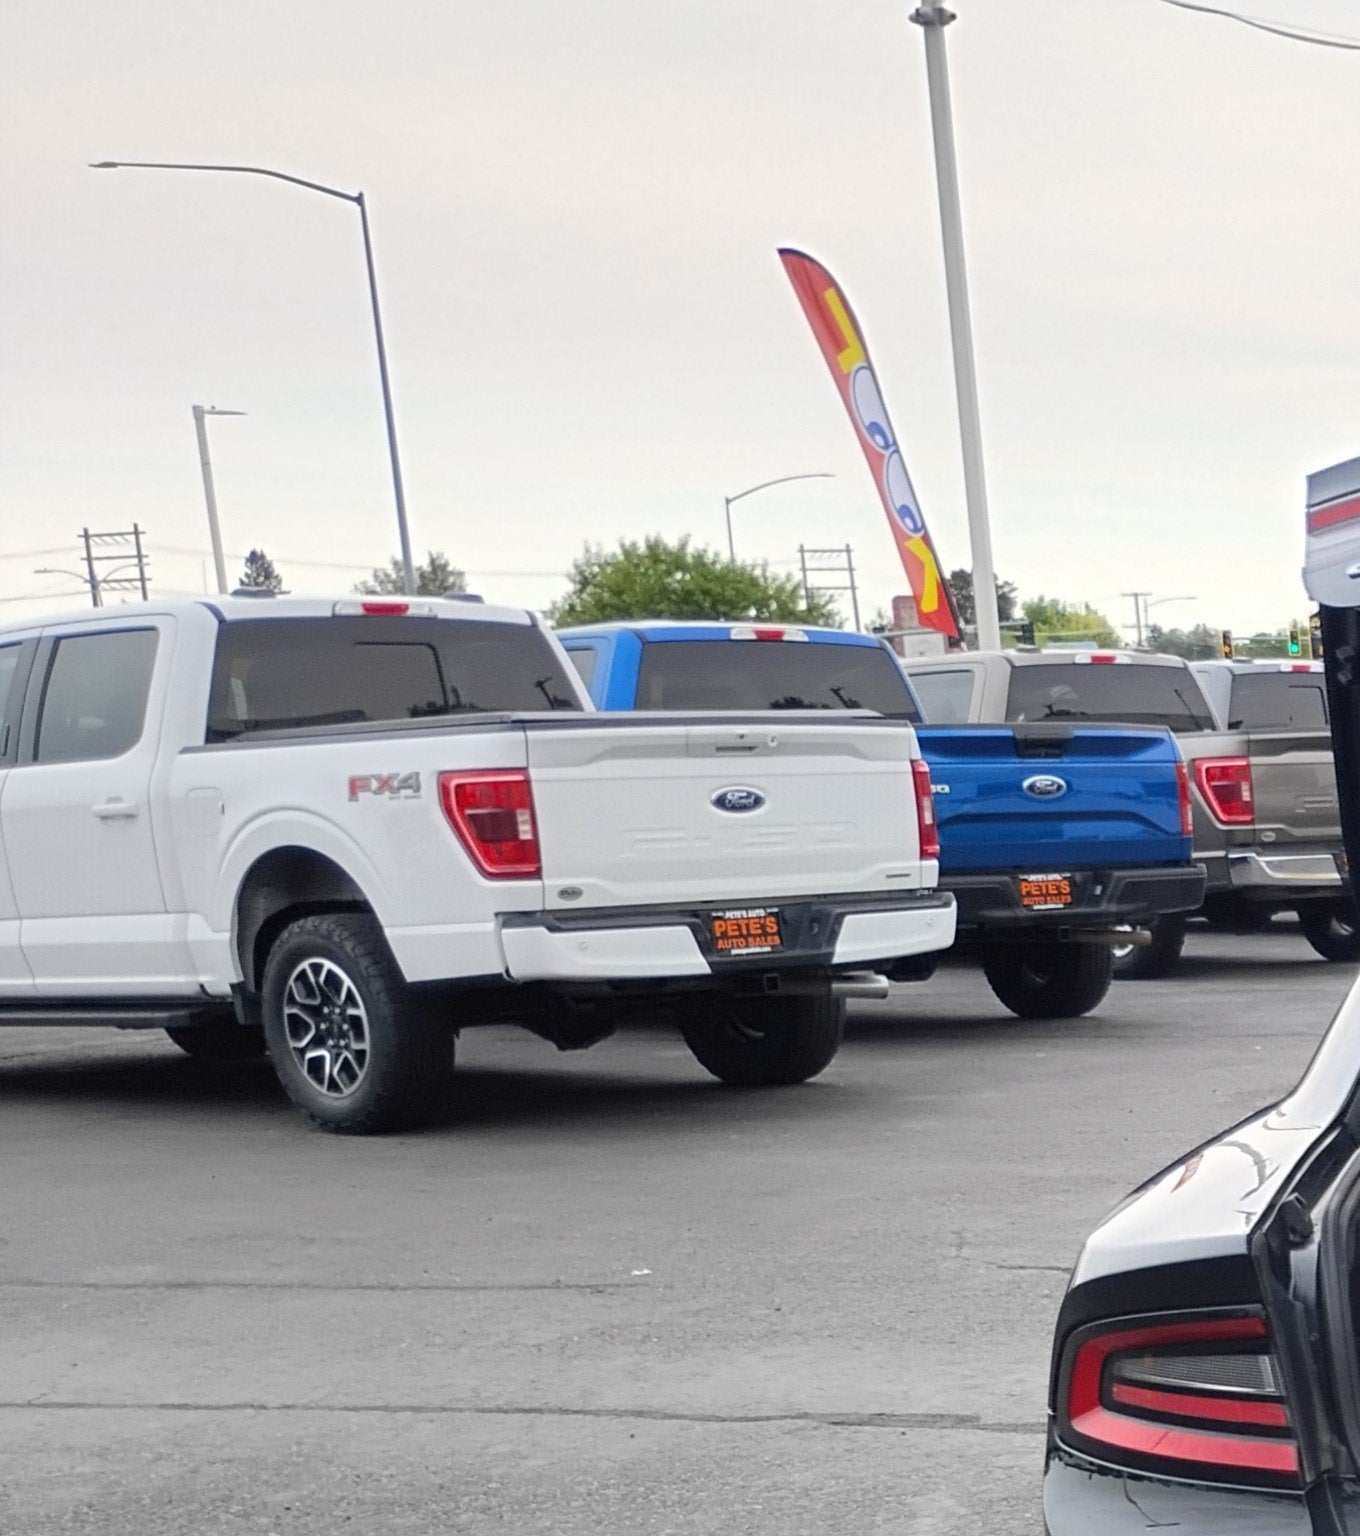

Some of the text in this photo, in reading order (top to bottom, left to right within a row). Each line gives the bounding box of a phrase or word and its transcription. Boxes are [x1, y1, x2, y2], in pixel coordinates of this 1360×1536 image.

[347, 771, 421, 802] FX4
[1021, 881, 1070, 895] PETE'S
[714, 917, 778, 936] PETE'S
[717, 936, 780, 949] AUTO SALES
